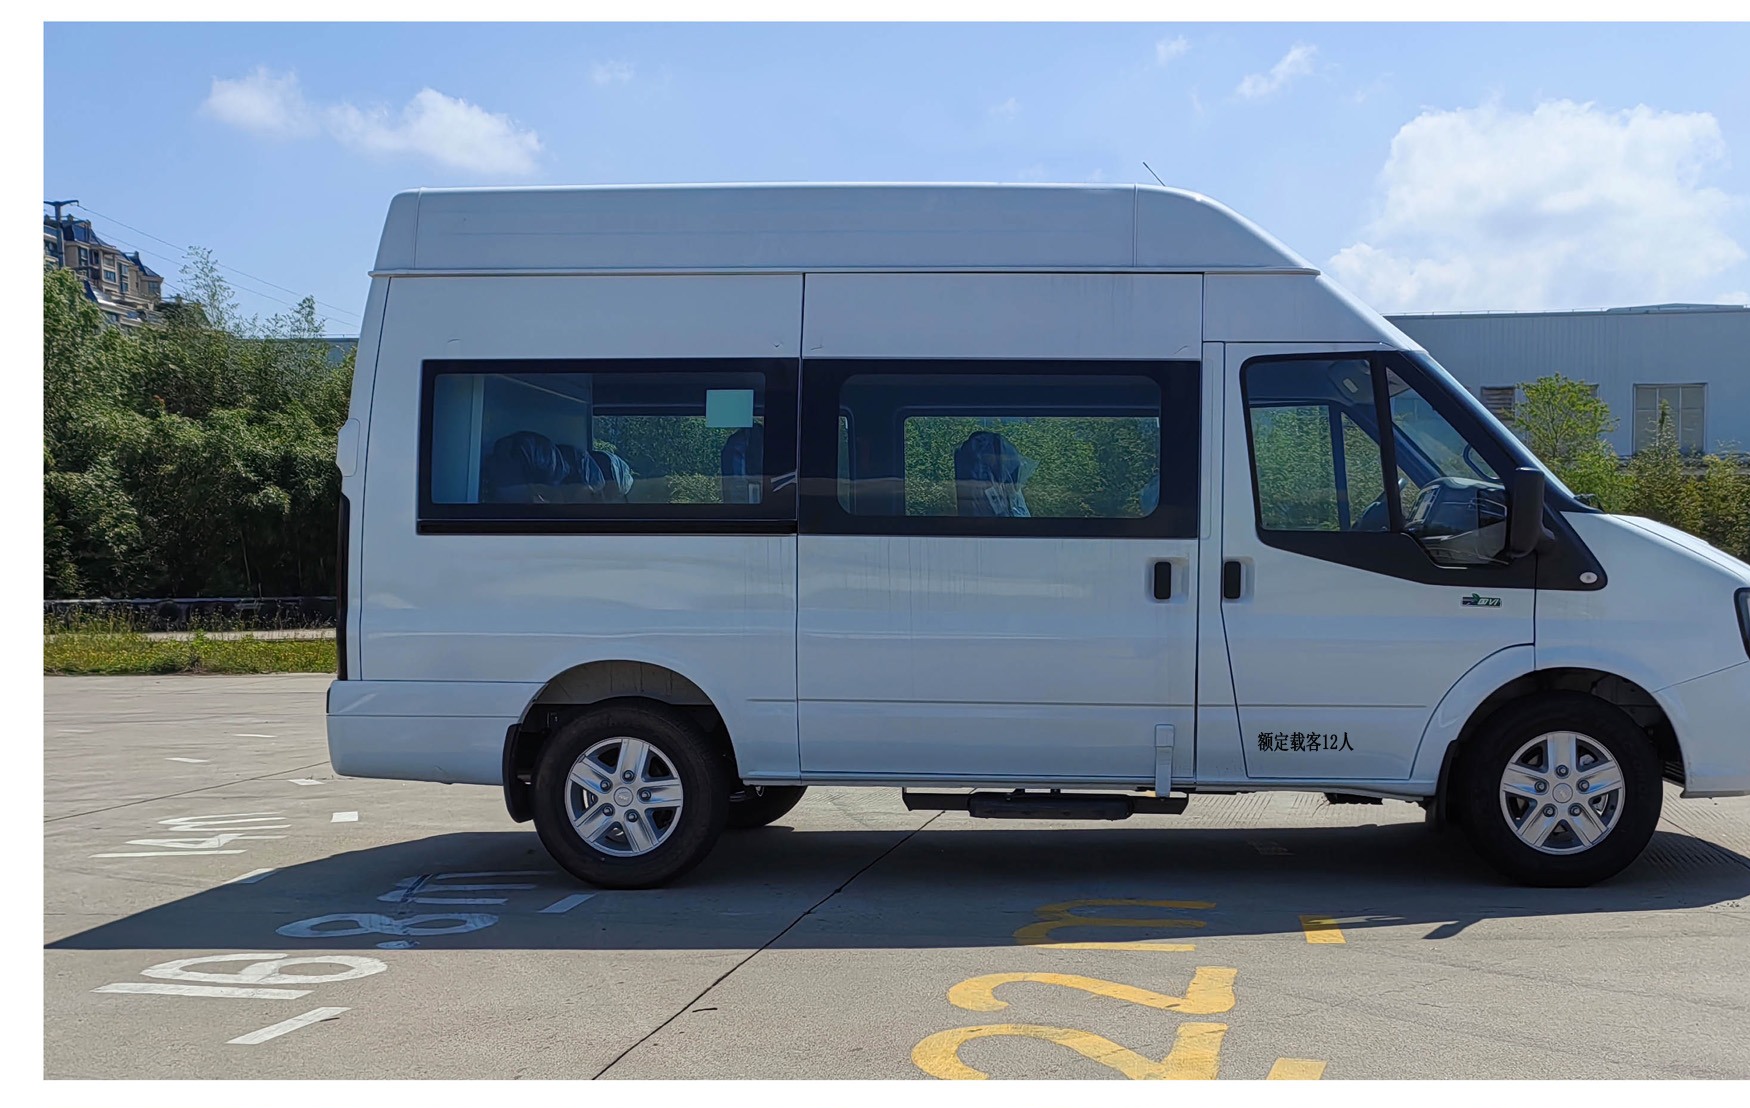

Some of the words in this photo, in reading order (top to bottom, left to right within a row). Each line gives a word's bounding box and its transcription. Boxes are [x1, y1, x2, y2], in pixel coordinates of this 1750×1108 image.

[1257, 731, 1354, 752] 额定载客12人
